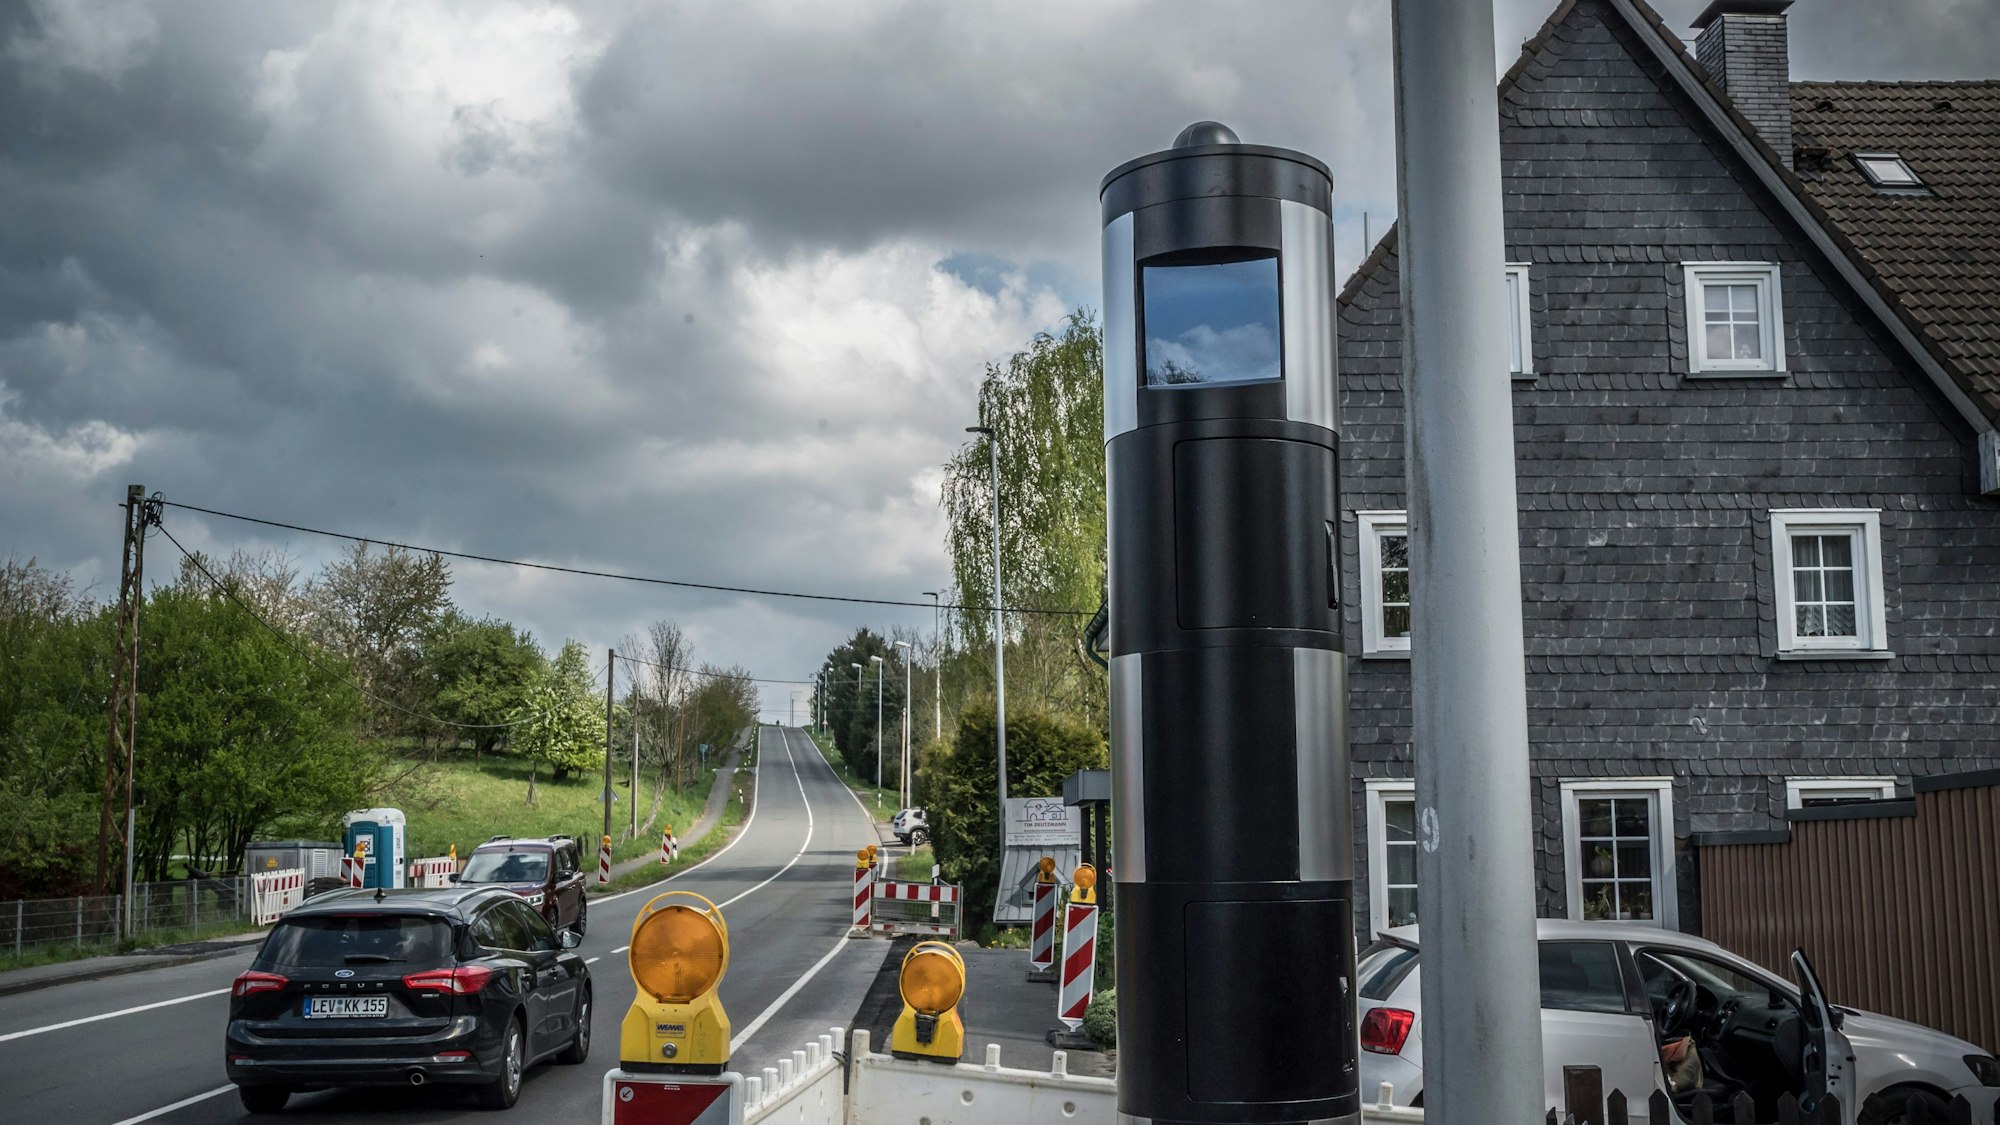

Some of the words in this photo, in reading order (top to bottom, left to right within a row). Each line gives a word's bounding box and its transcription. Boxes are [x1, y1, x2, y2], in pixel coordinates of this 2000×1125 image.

[1422, 807, 1439, 853] 9
[312, 1000, 336, 1013] LEV
[344, 999, 359, 1012] KK
[362, 999, 385, 1012] 155
